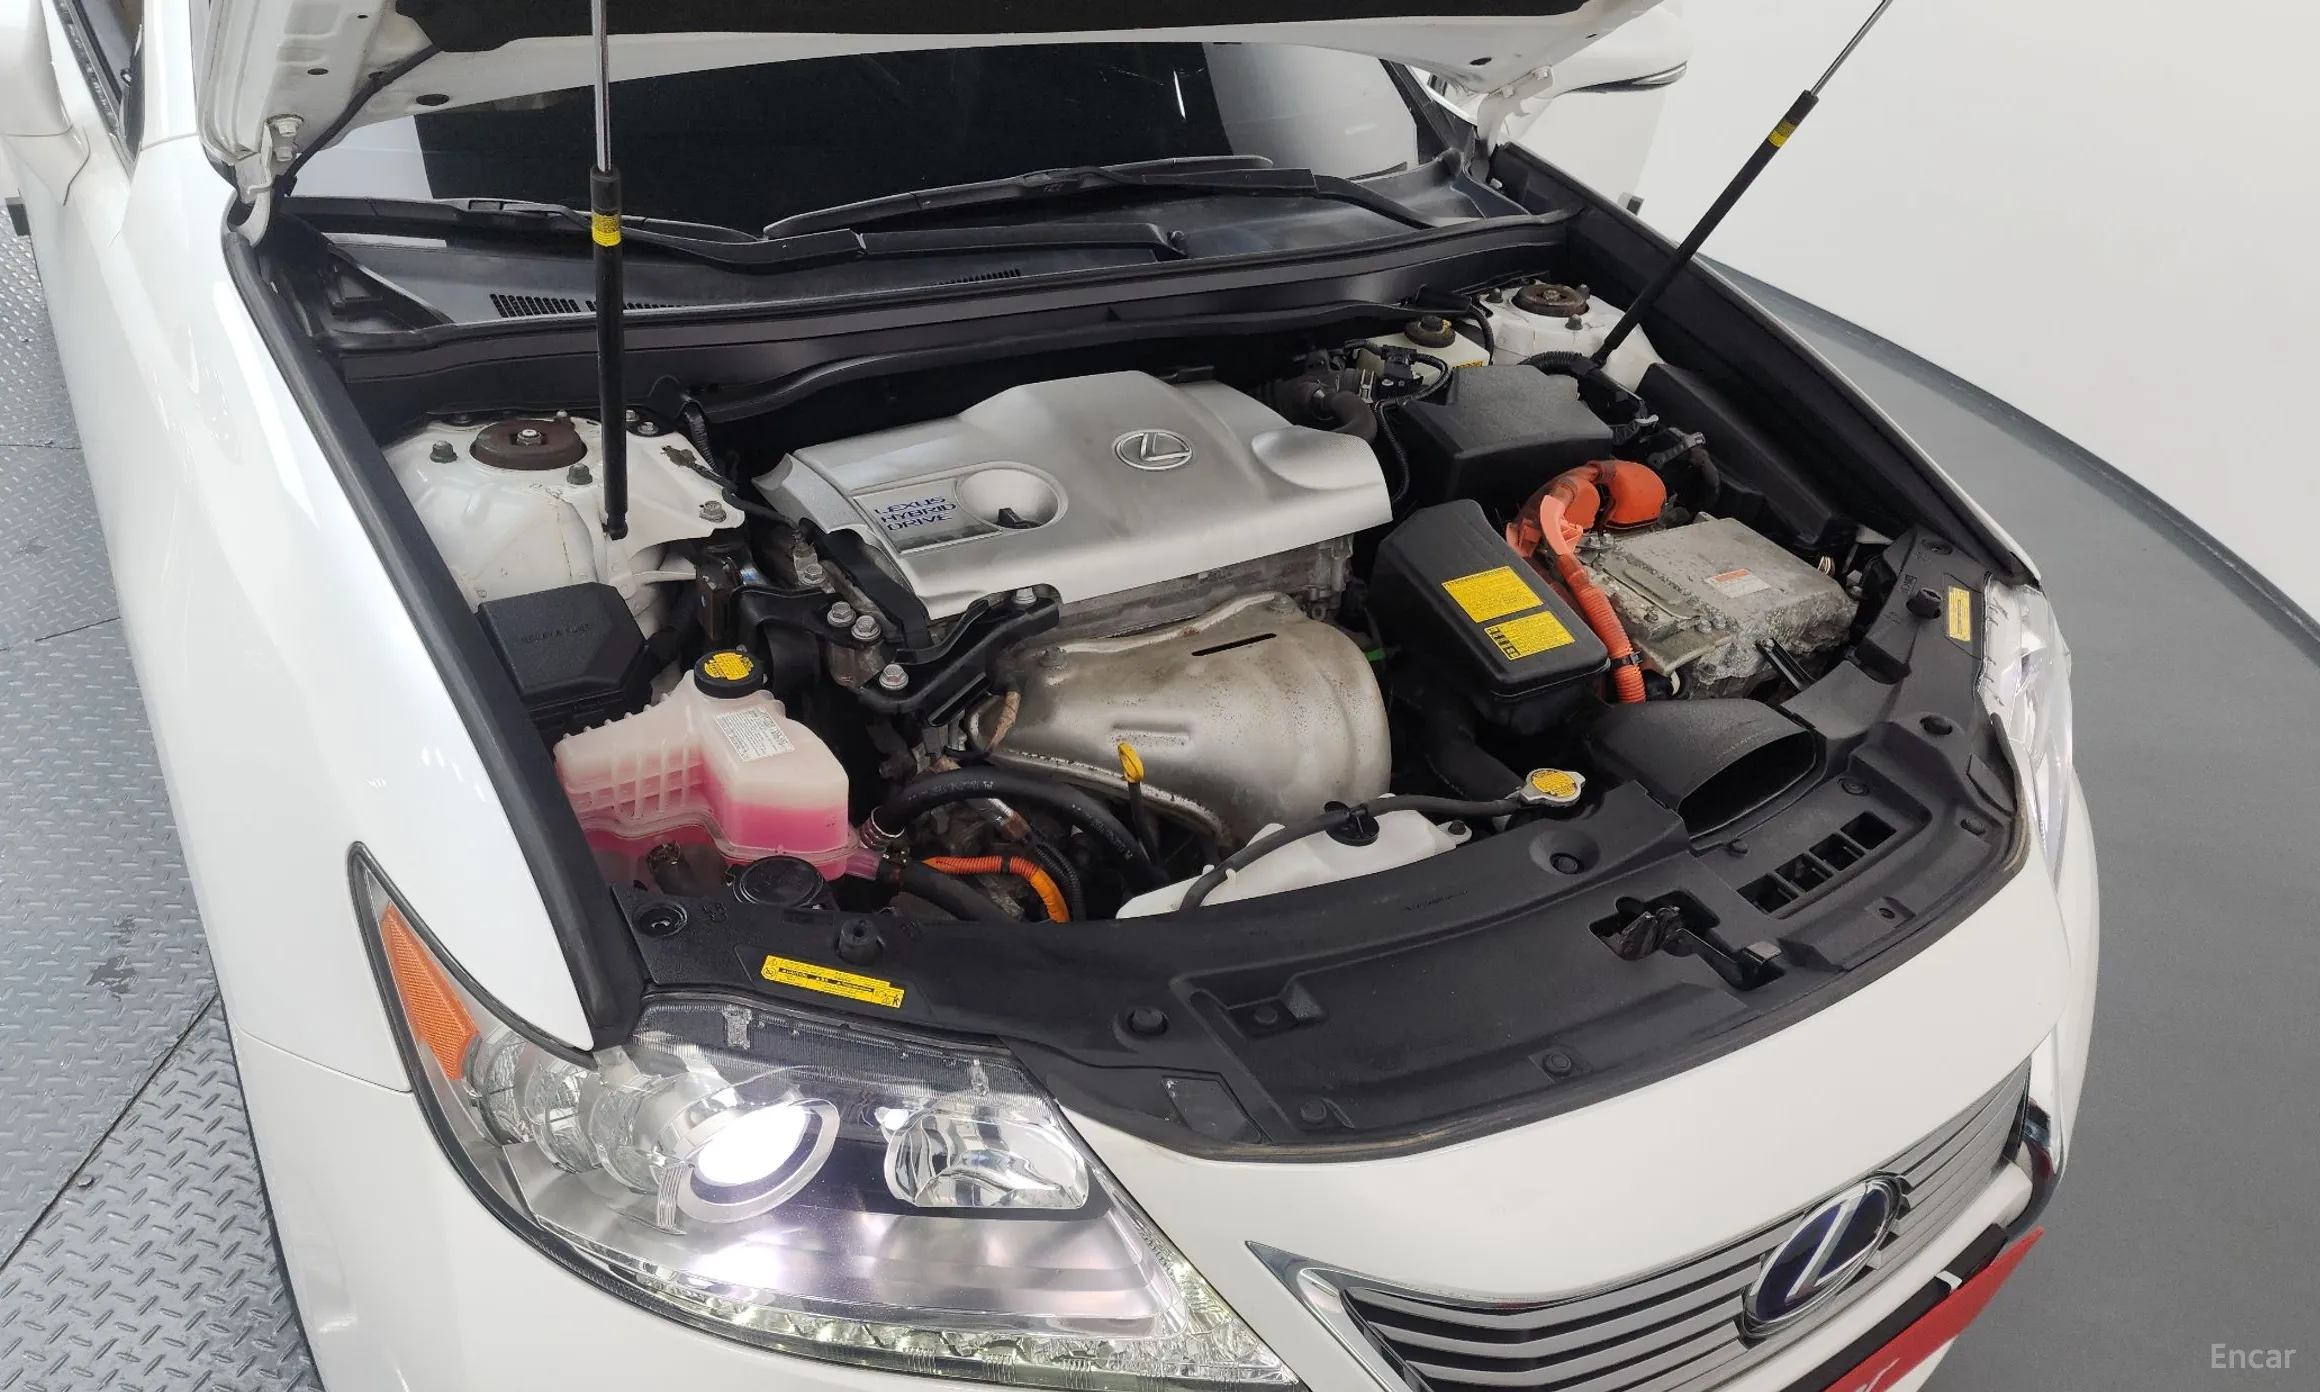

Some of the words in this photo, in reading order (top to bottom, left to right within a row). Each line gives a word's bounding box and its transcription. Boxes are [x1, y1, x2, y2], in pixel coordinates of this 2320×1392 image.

[874, 496, 946, 514] LEXUS
[880, 504, 956, 523] HYBRID
[887, 513, 952, 531] DRIVE
